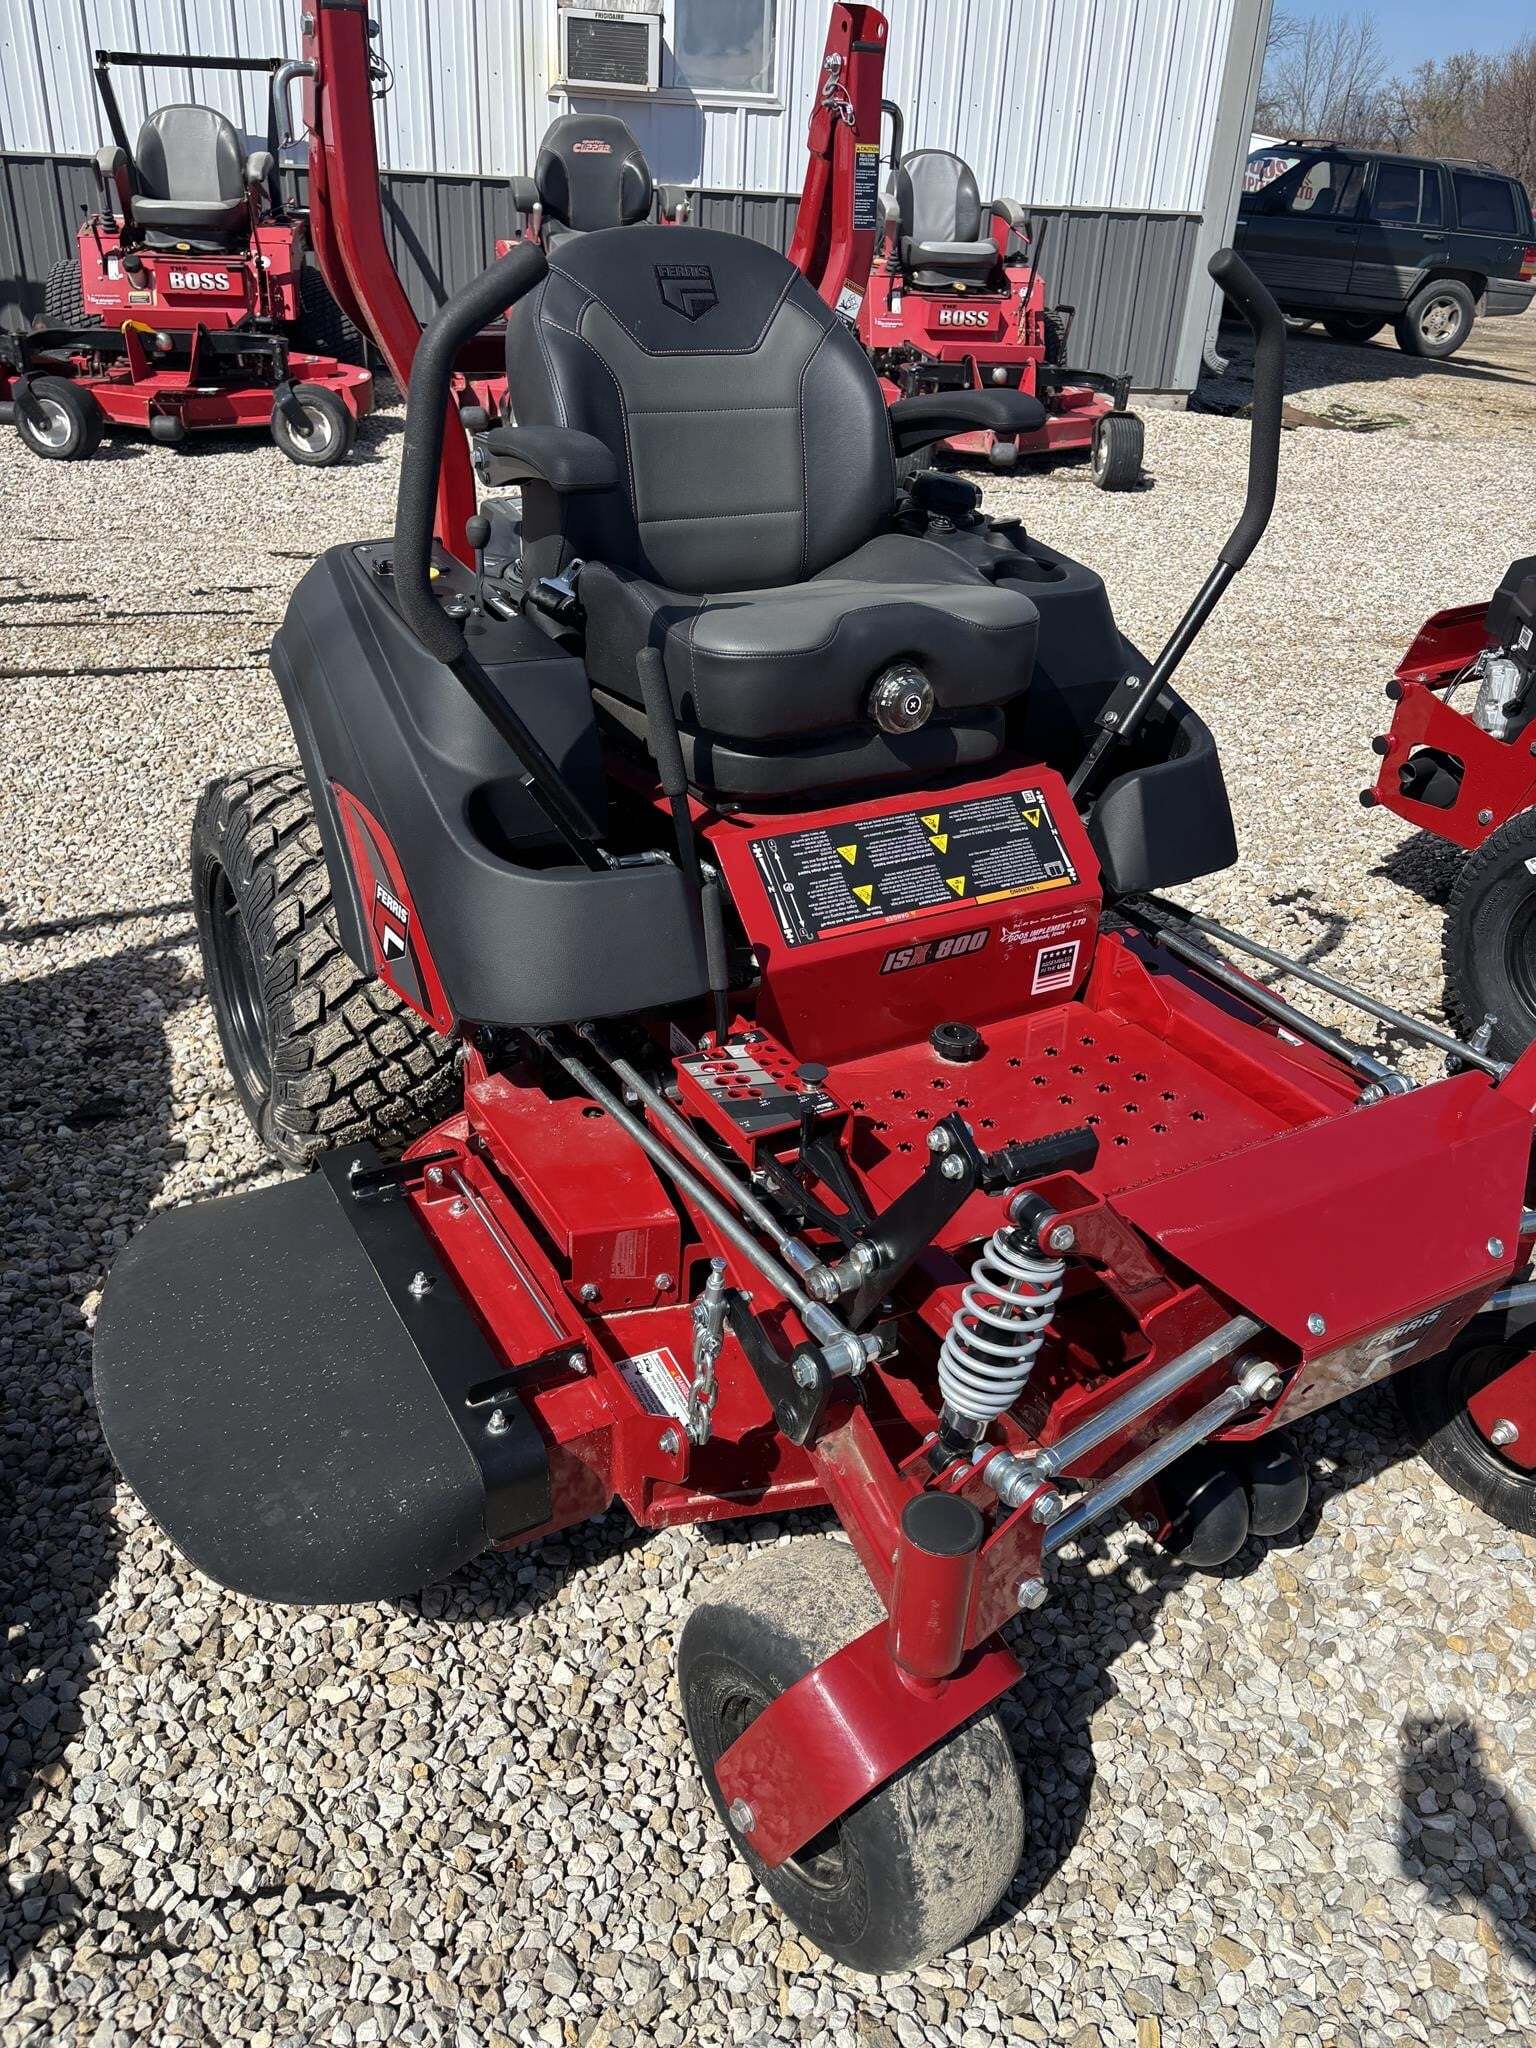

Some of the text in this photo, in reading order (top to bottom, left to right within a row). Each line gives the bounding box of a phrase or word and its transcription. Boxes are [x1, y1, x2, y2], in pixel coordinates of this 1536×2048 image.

[594, 12, 625, 20] FRIGIDAIRE
[656, 265, 711, 277] FERRIS
[169, 271, 230, 291] BOSS
[938, 310, 989, 327] BOSS
[1008, 885, 1035, 894] WARNING
[376, 884, 409, 924] FERRIS
[883, 911, 909, 921] DANGER
[1007, 931, 1030, 943] GOOS
[1029, 921, 1072, 938] IMPLEMENT,
[883, 930, 988, 973] ISX 800
[1041, 955, 1072, 968] ASSEMBLED
[1056, 962, 1070, 970] USA
[1364, 1309, 1442, 1350] FERRIS
